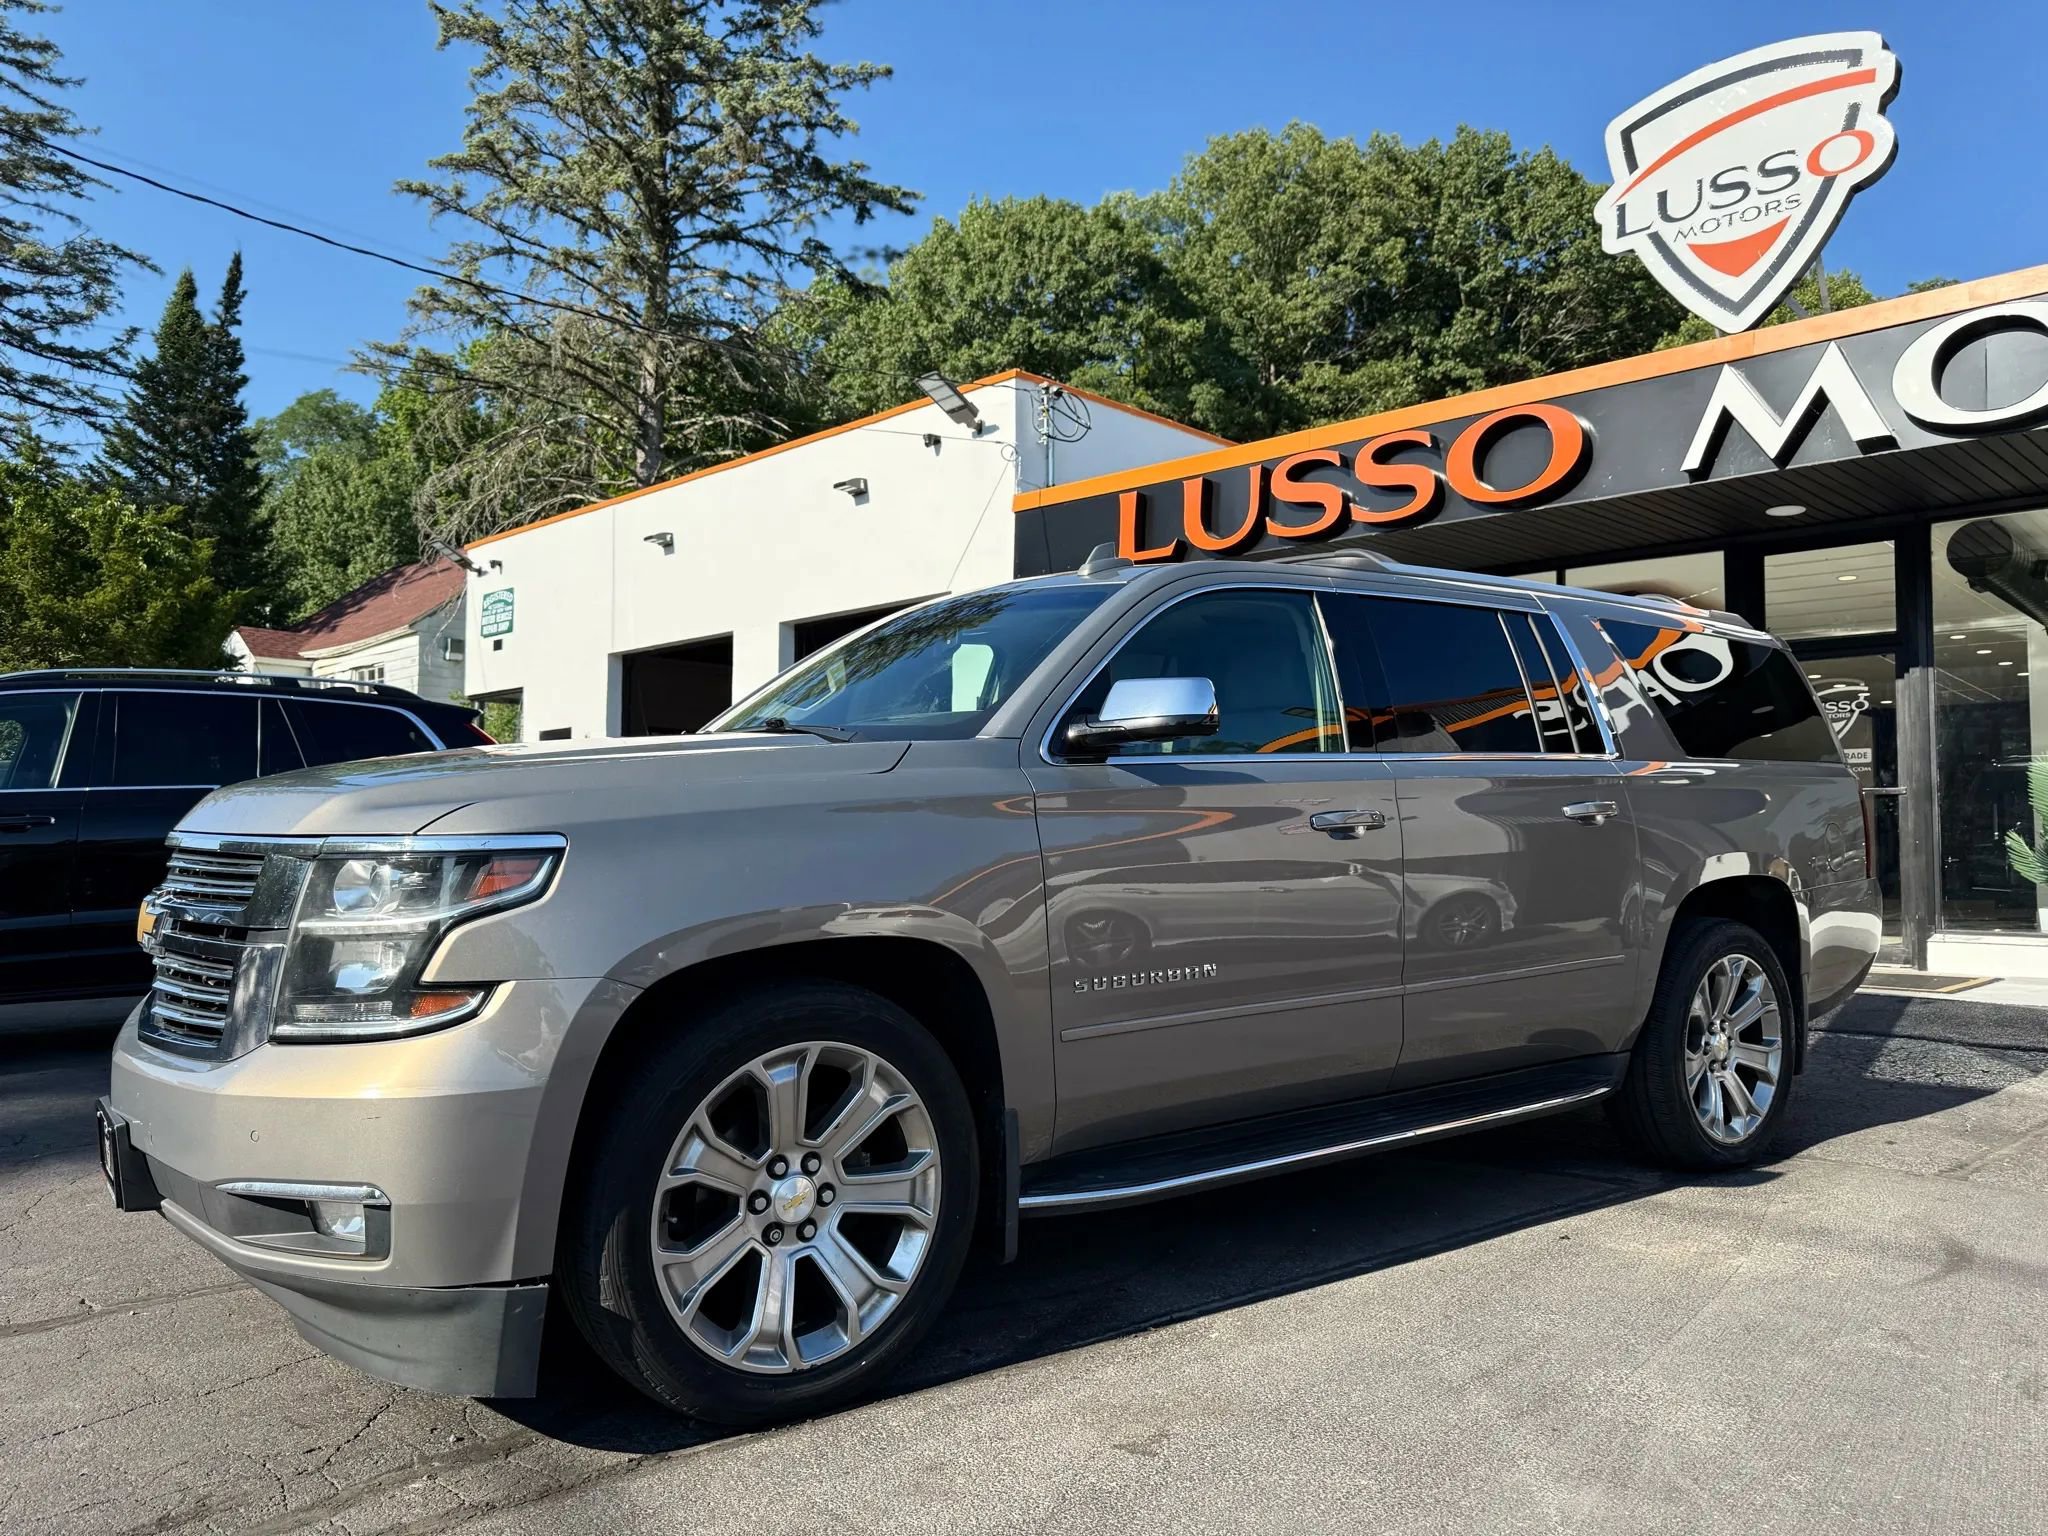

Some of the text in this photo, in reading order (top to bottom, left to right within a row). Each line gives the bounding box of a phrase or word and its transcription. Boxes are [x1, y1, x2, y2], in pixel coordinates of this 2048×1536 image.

[1616, 130, 1875, 239] LUSSO
[1674, 193, 1802, 243] MOTORS
[1118, 403, 1588, 562] LUSSO
[1822, 699, 1869, 713] SSO
[1074, 963, 1217, 993] SUBURBAN
